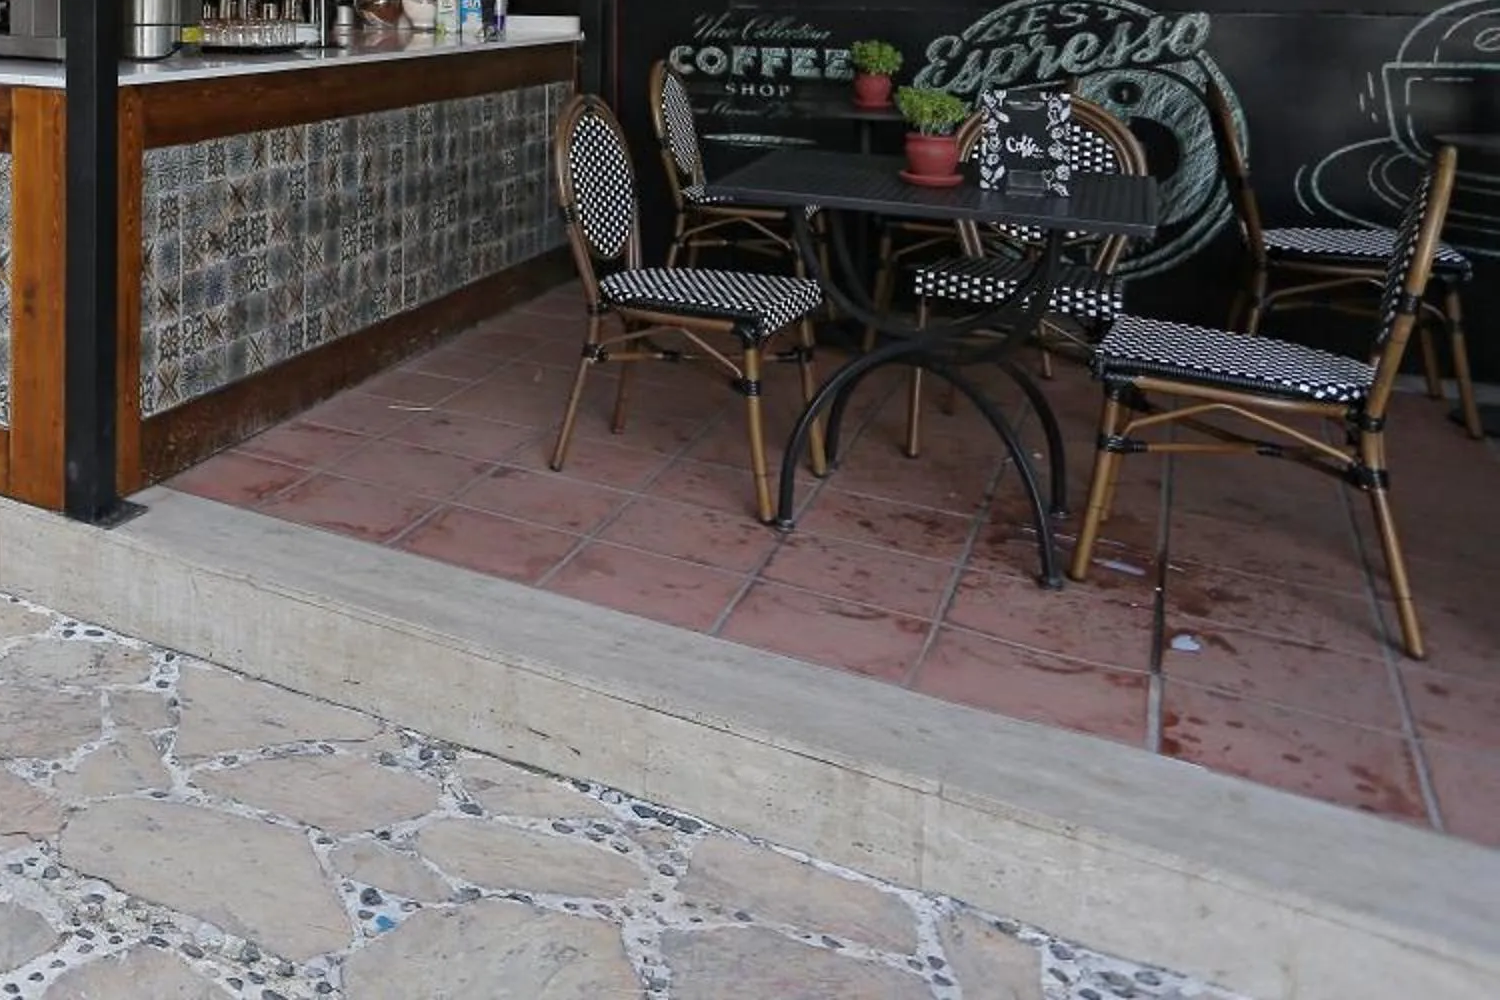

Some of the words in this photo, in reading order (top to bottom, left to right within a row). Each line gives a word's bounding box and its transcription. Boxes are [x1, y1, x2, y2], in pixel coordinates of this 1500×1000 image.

[974, 2, 1126, 43] BEST
[669, 45, 855, 80] COFFEE
[912, 11, 1211, 103] Espresso
[725, 83, 792, 98] SHOP
